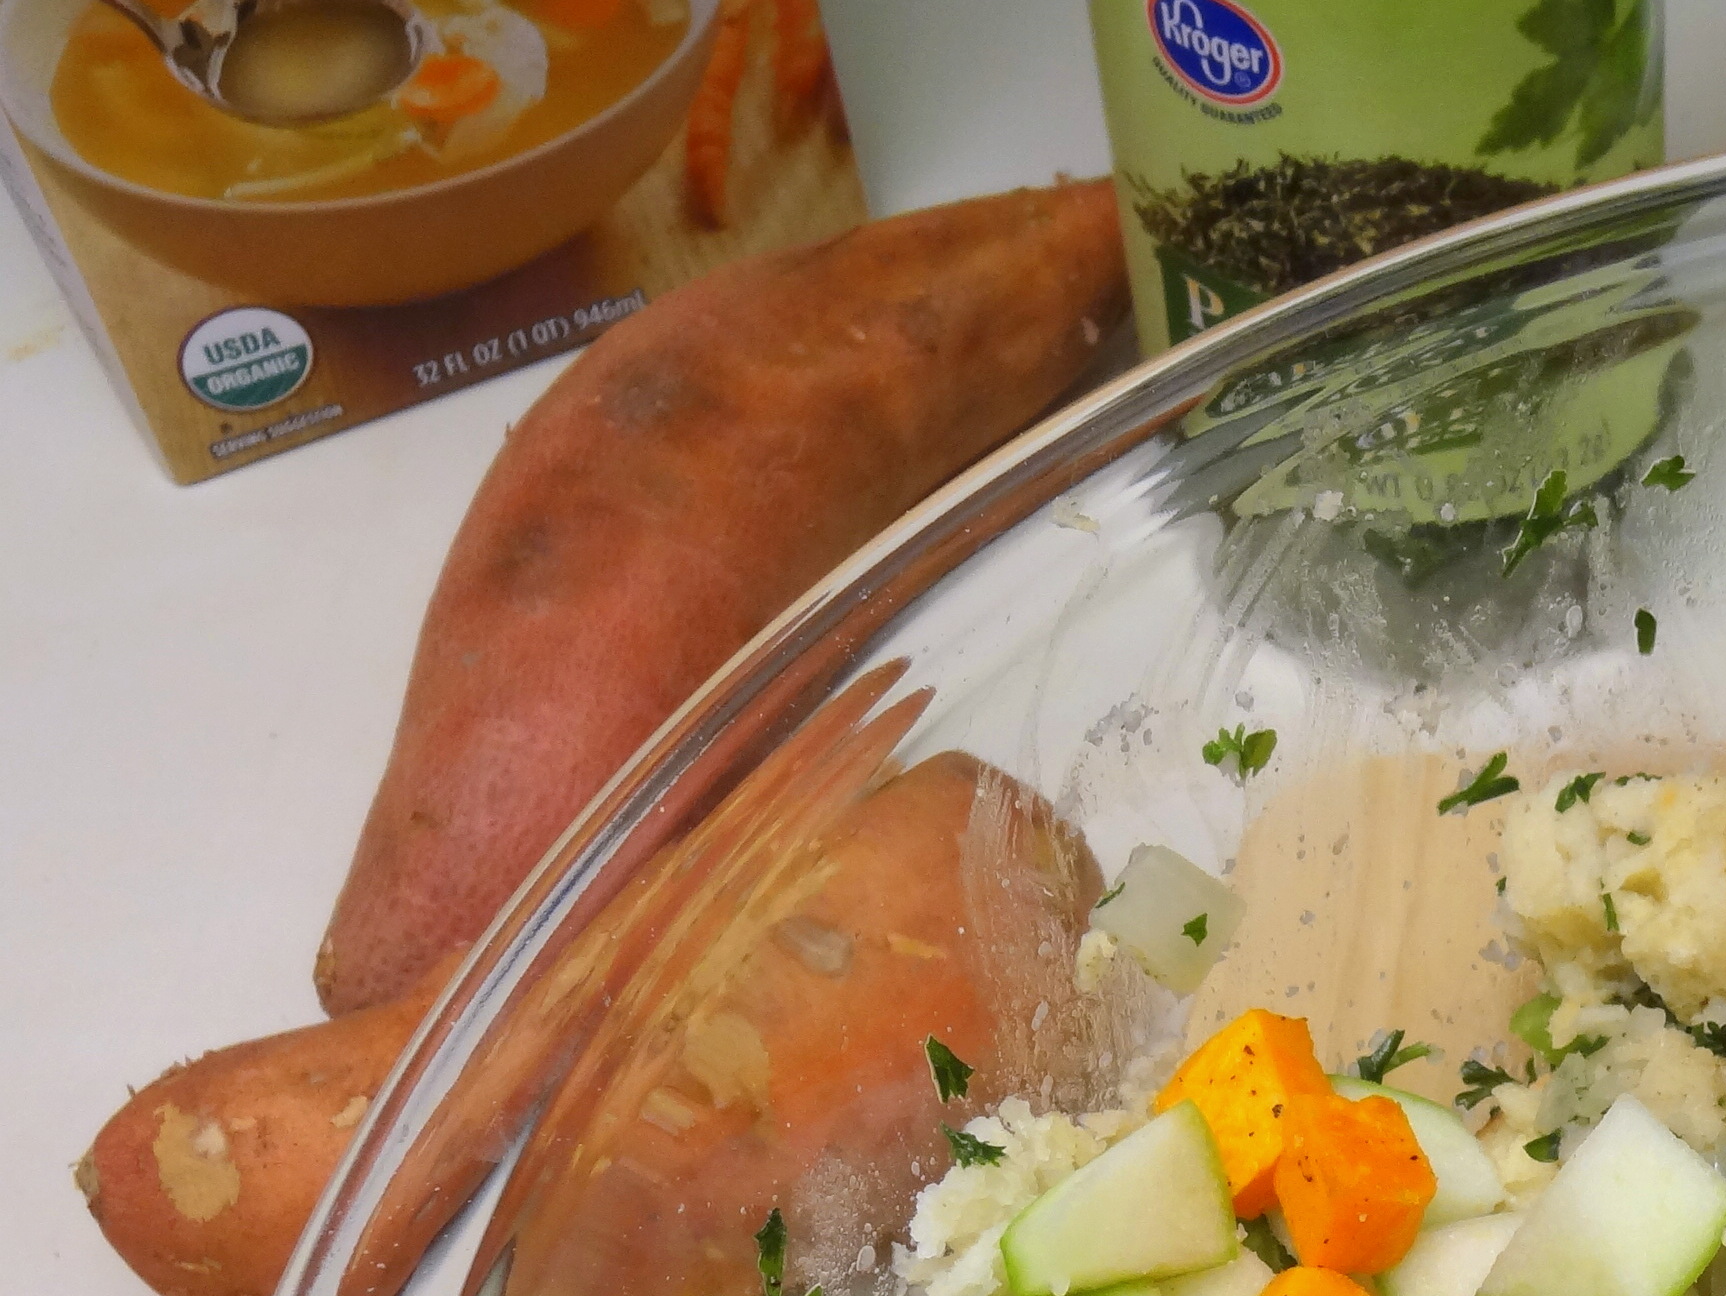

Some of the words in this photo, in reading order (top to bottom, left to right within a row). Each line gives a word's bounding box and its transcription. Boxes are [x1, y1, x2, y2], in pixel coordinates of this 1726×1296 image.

[1160, 0, 1264, 86] Kroger
[1153, 56, 1197, 105] QUALITY
[1201, 102, 1283, 125] GUARANTEED
[203, 326, 281, 365] USDA
[206, 352, 300, 395] ORGANIC
[412, 359, 442, 388] 32
[443, 351, 469, 377] FL
[472, 338, 503, 367] OZ
[507, 328, 529, 358] (1
